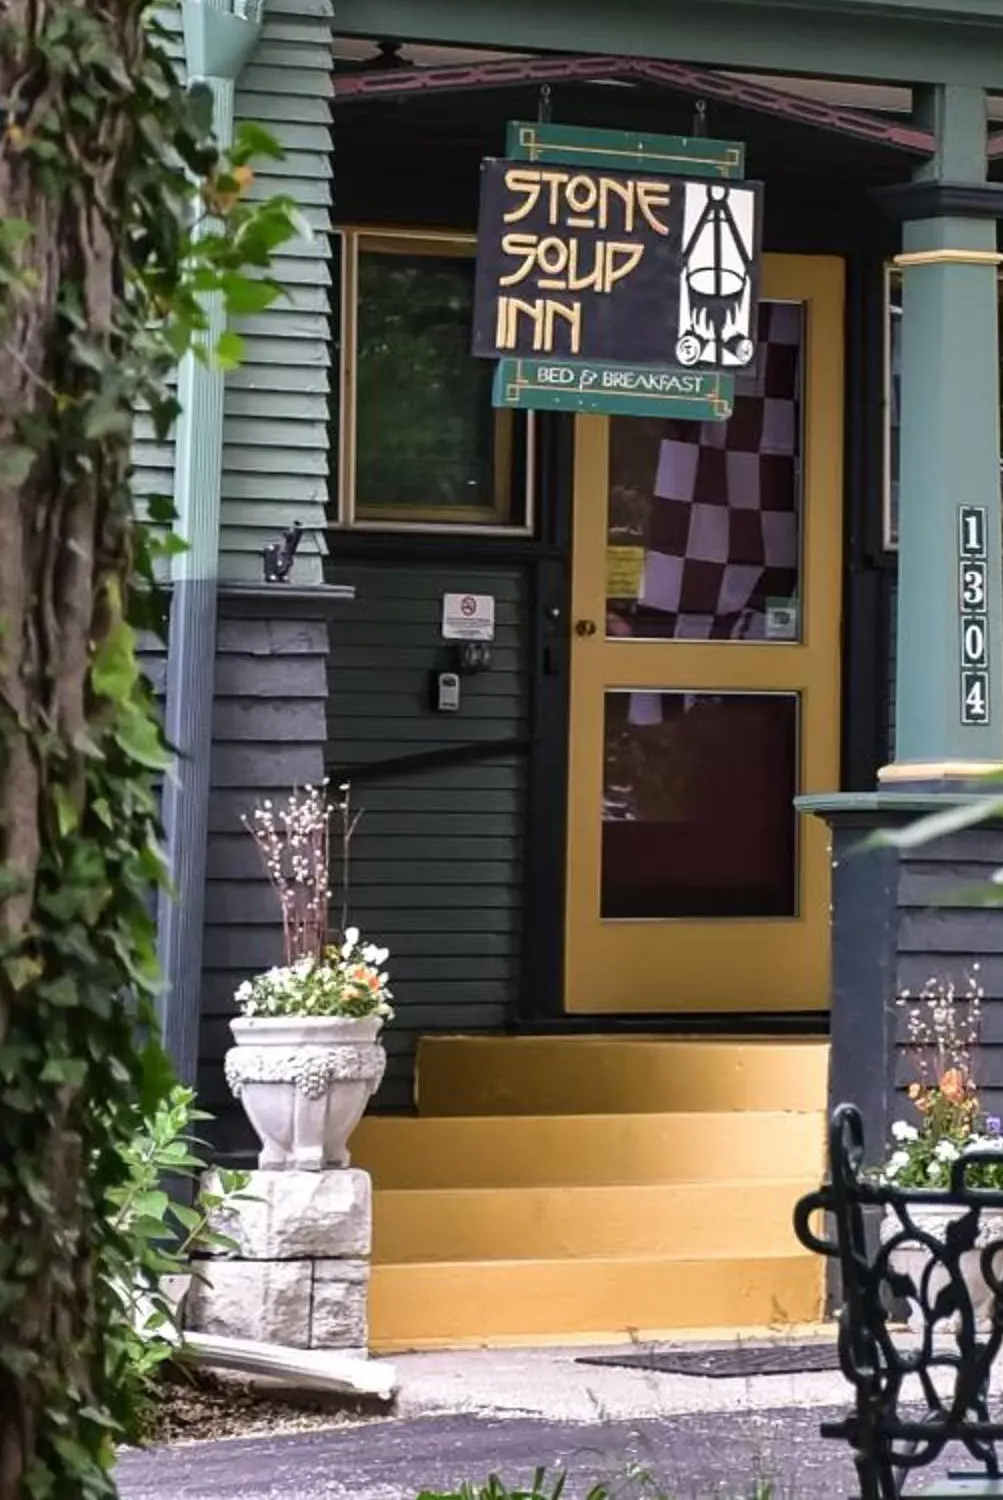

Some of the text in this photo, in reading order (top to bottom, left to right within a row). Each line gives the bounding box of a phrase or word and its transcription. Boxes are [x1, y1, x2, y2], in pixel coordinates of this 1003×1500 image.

[503, 169, 670, 236] STONE
[499, 233, 645, 293] SOUP
[495, 296, 581, 354] INN
[537, 366, 575, 384] BED
[602, 370, 704, 394] BREAKFAST
[963, 515, 986, 716] 1304
